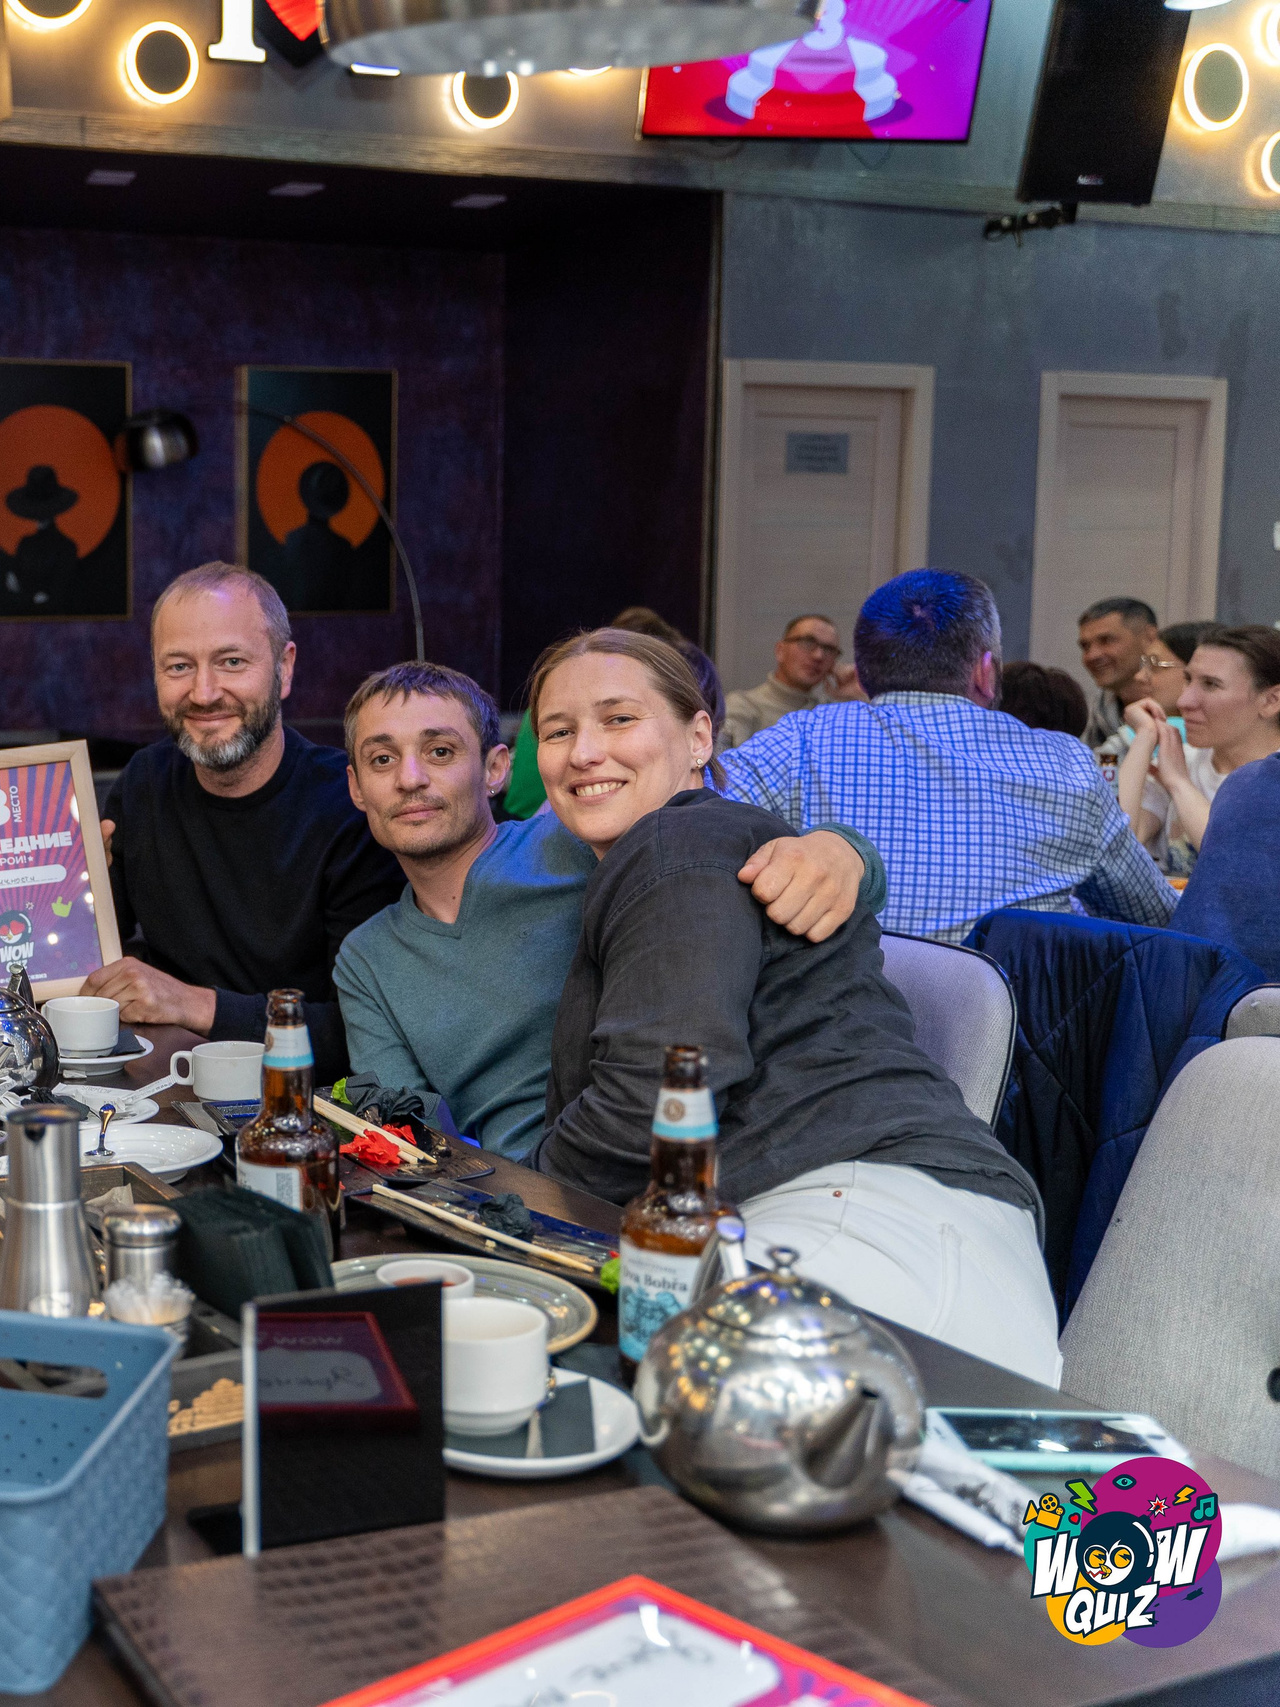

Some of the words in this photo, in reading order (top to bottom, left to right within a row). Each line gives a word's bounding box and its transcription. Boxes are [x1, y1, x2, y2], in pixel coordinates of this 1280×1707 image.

[9, 785, 22, 823] МЕСТО
[0, 942, 34, 962] WOW
[6, 960, 27, 972] QZ
